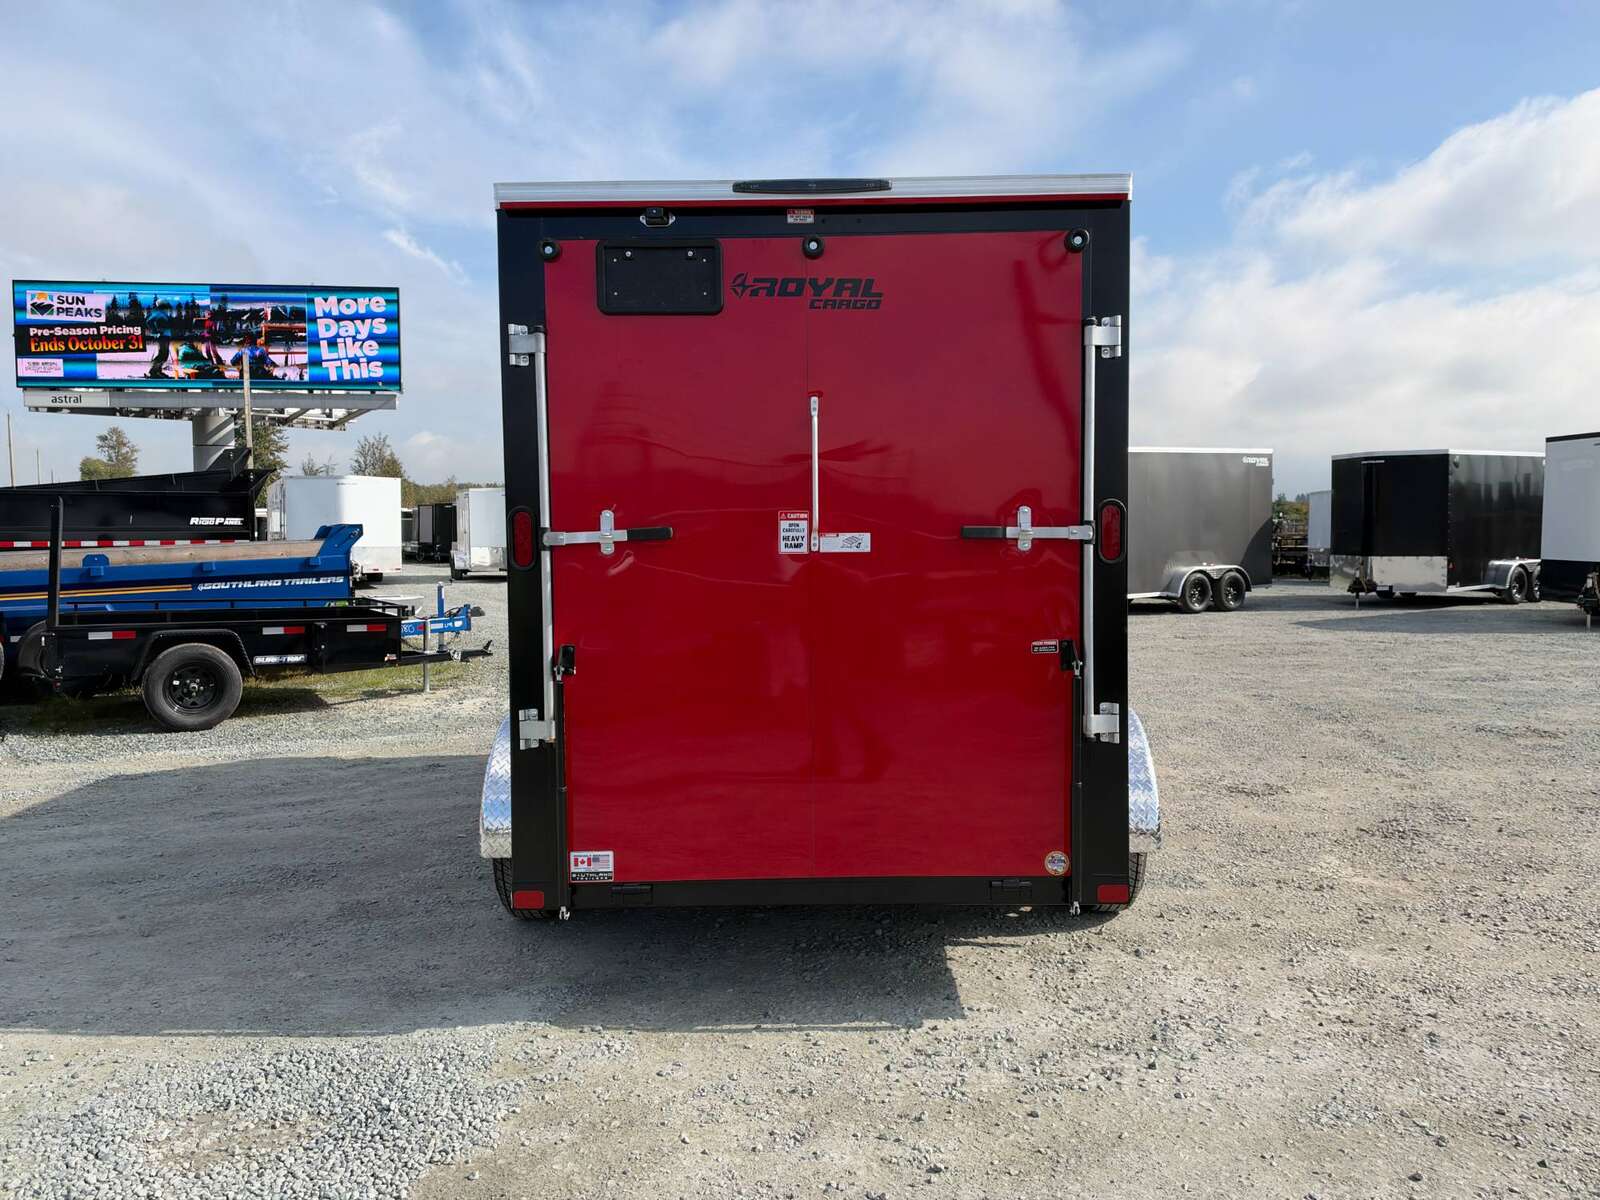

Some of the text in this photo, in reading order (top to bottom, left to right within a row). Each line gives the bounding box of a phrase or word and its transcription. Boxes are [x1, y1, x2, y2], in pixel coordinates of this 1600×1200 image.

[750, 277, 884, 298] ROYAL
[56, 294, 86, 305] SUN
[314, 295, 387, 317] More
[808, 299, 881, 310] CARGO
[56, 306, 102, 318] PEAKS
[29, 325, 142, 336] Pre-Season Pricing
[317, 317, 388, 340] Days
[30, 335, 143, 352] Ends October 31
[319, 337, 380, 360] Like
[321, 357, 384, 381] This
[51, 393, 82, 404] astral
[203, 576, 344, 590] SOUTHLAND TRAILERS
